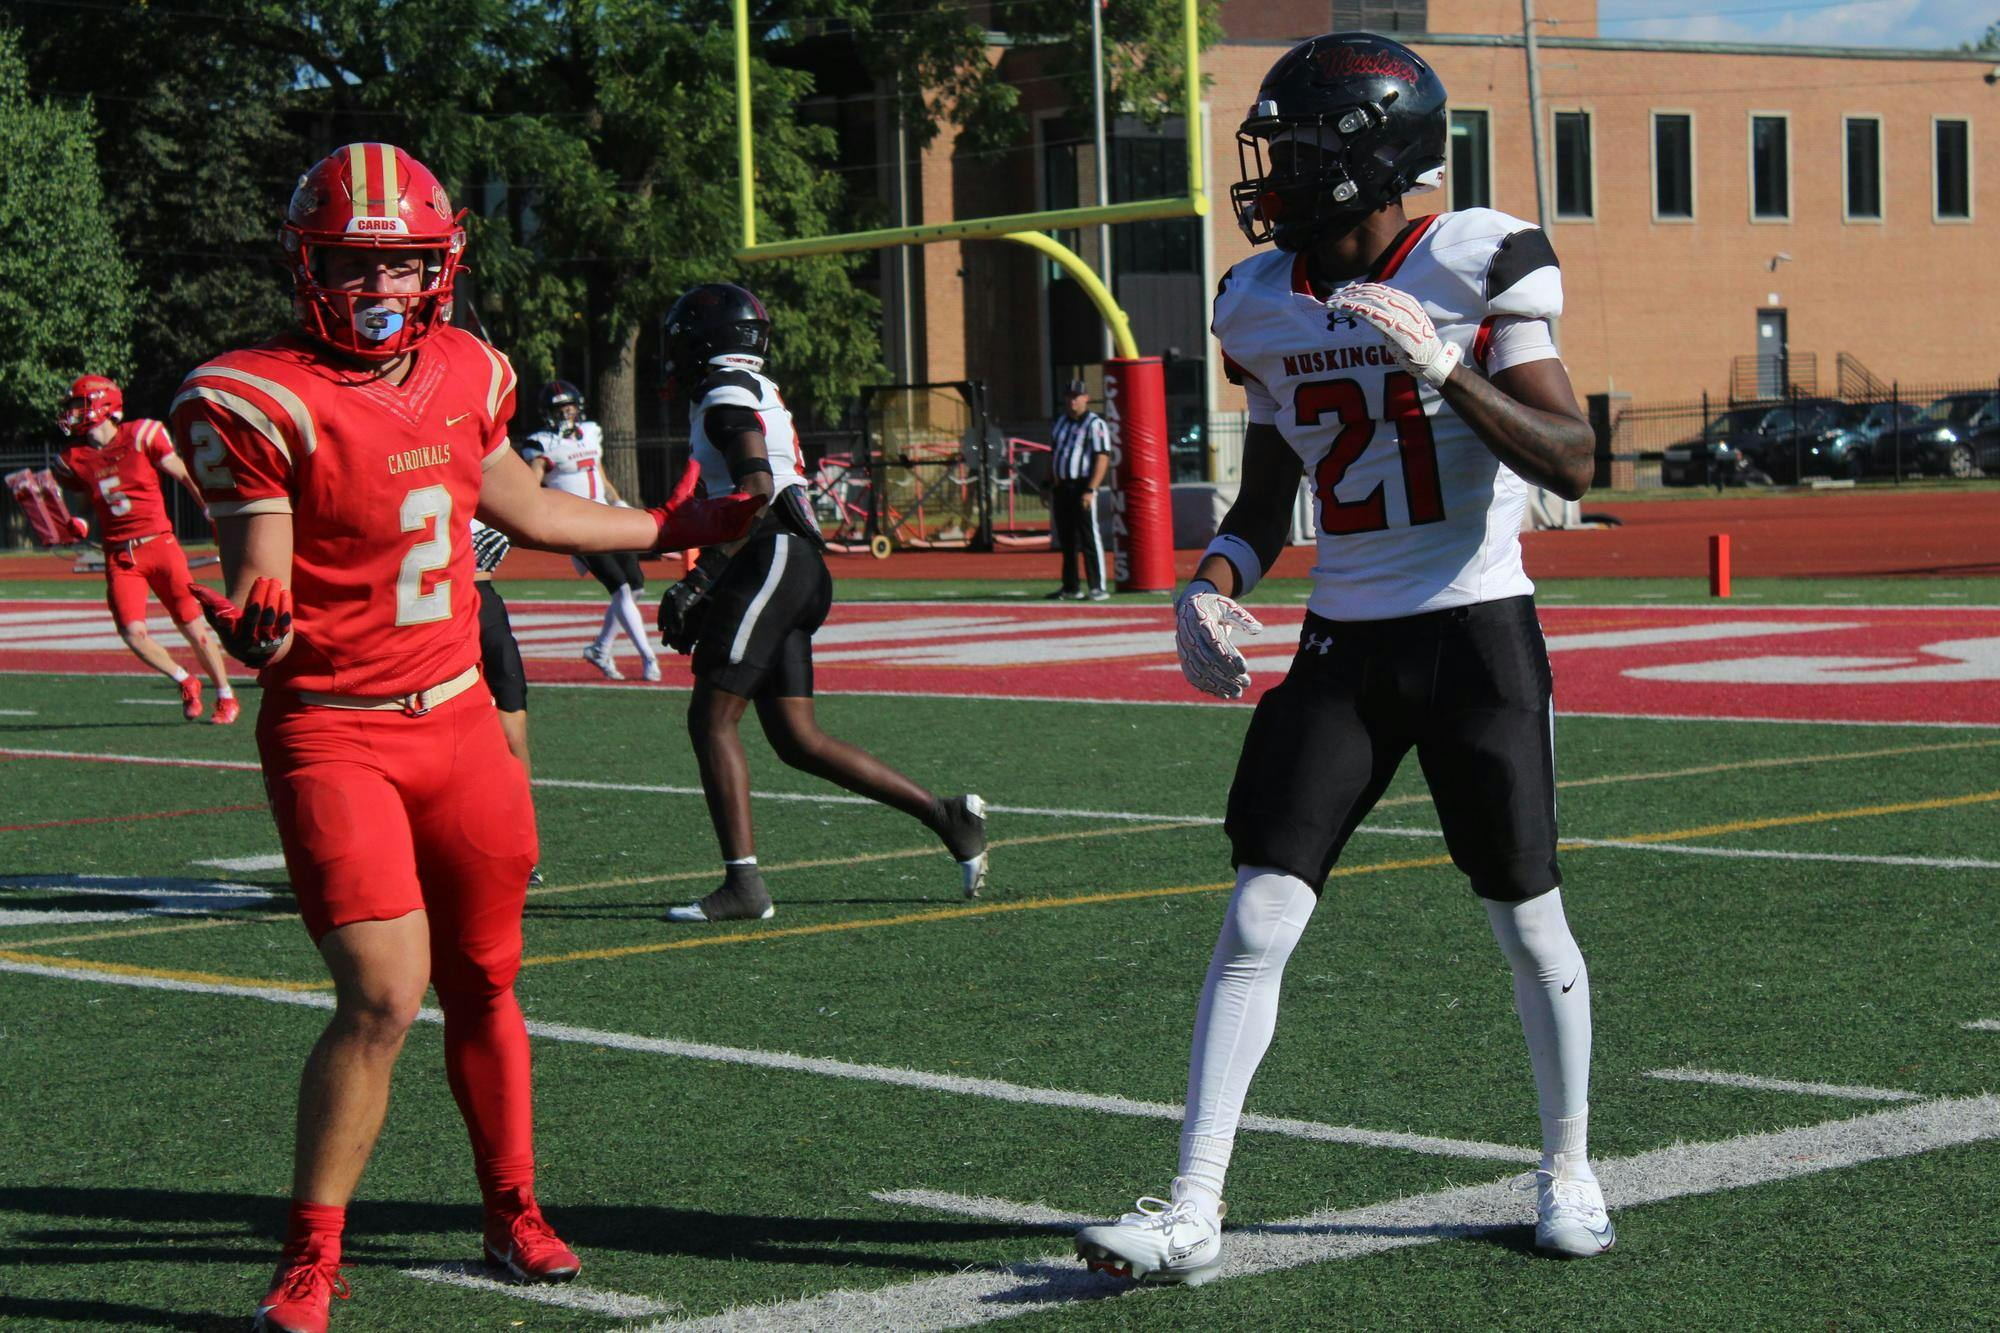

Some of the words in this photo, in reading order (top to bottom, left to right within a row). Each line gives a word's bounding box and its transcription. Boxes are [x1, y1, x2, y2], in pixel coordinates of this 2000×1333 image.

[358, 220, 397, 231] CARDS
[1282, 345, 1400, 376] MUSKINGU
[189, 421, 236, 489] 2
[388, 444, 450, 475] CARDINALS
[1293, 370, 1446, 536] 21
[99, 476, 132, 517] 5
[576, 458, 596, 500] 7
[1104, 375, 1129, 582] CARDINALS
[395, 483, 453, 627] 2
